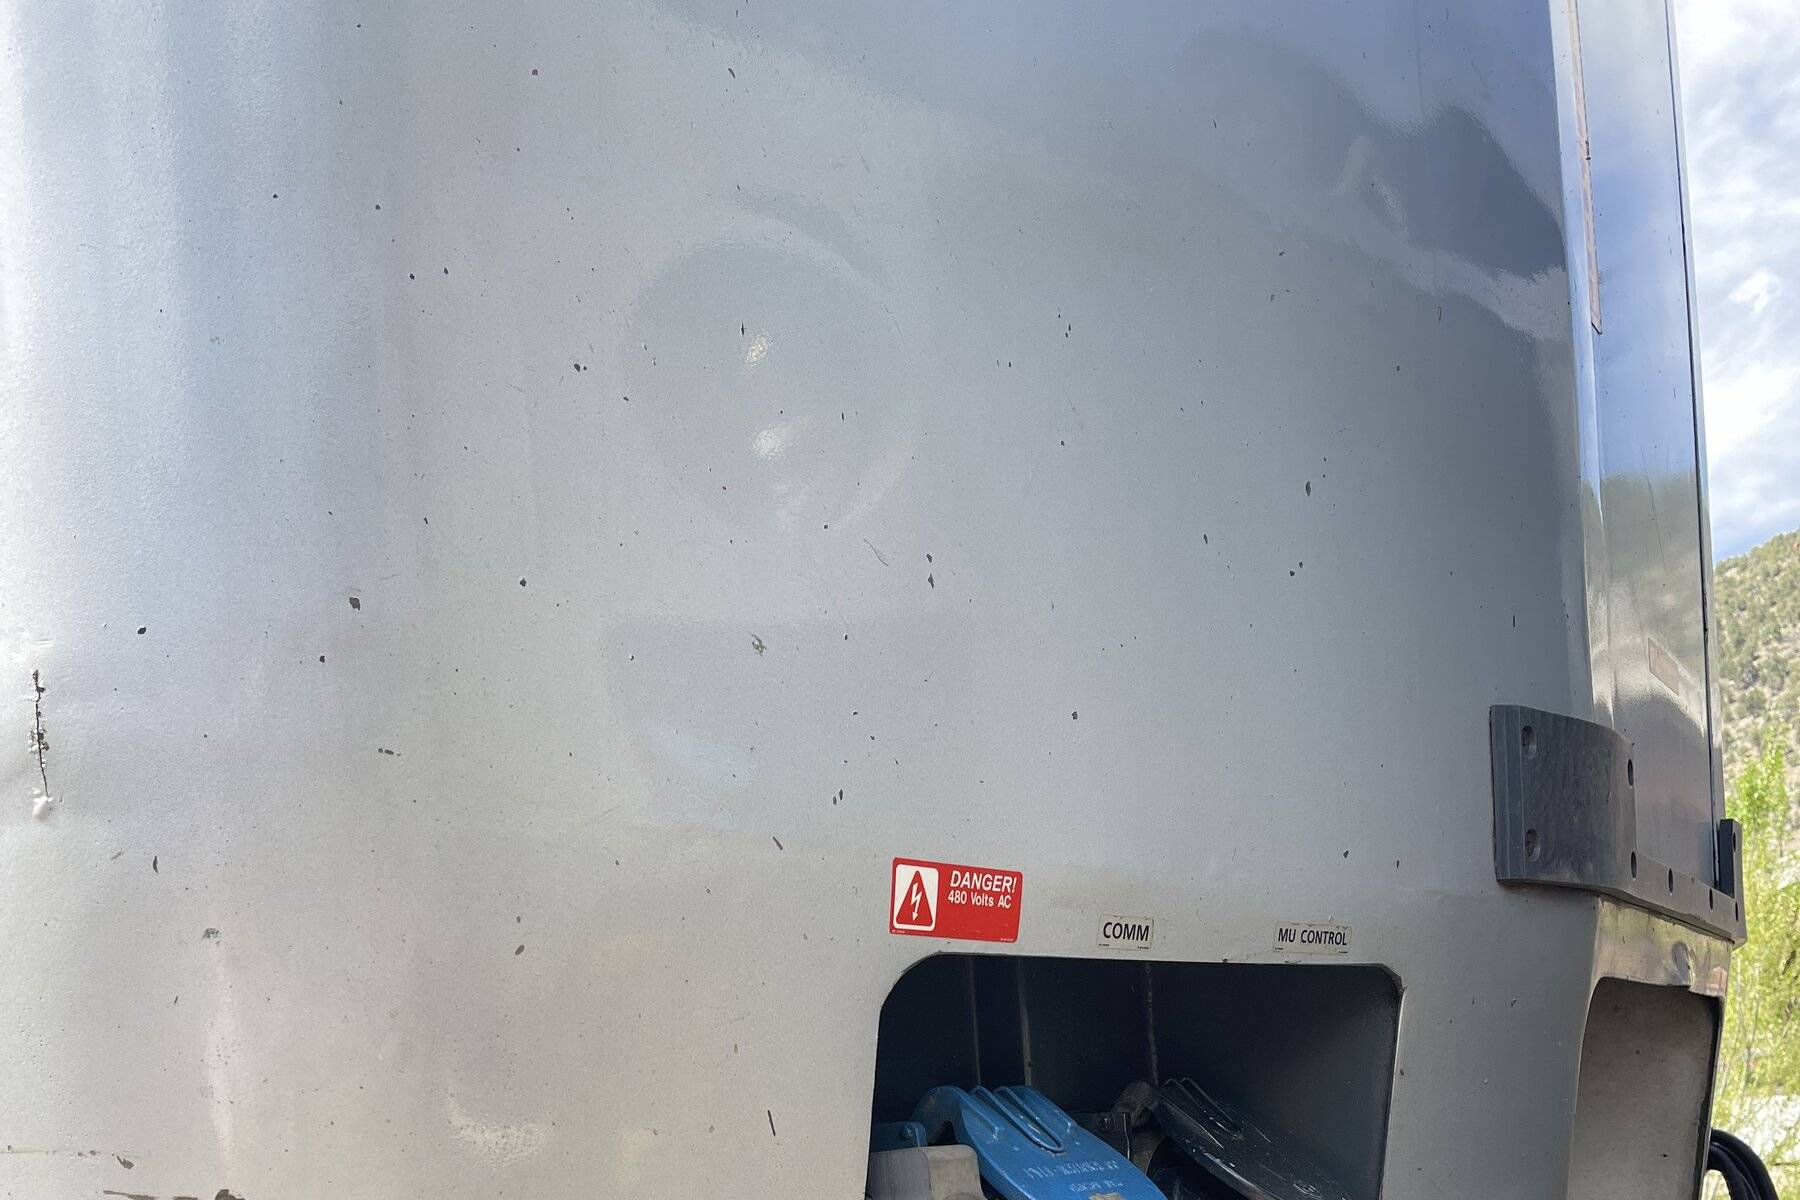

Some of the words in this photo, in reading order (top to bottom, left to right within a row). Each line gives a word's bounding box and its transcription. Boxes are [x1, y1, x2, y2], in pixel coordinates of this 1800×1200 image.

[950, 870, 1017, 893] DANGER!
[948, 890, 967, 905] 480
[971, 892, 994, 907] Volts
[997, 895, 1012, 909] AC
[1103, 921, 1150, 942] COMM
[1278, 928, 1297, 943] MU
[1300, 929, 1347, 946] CONTROL
